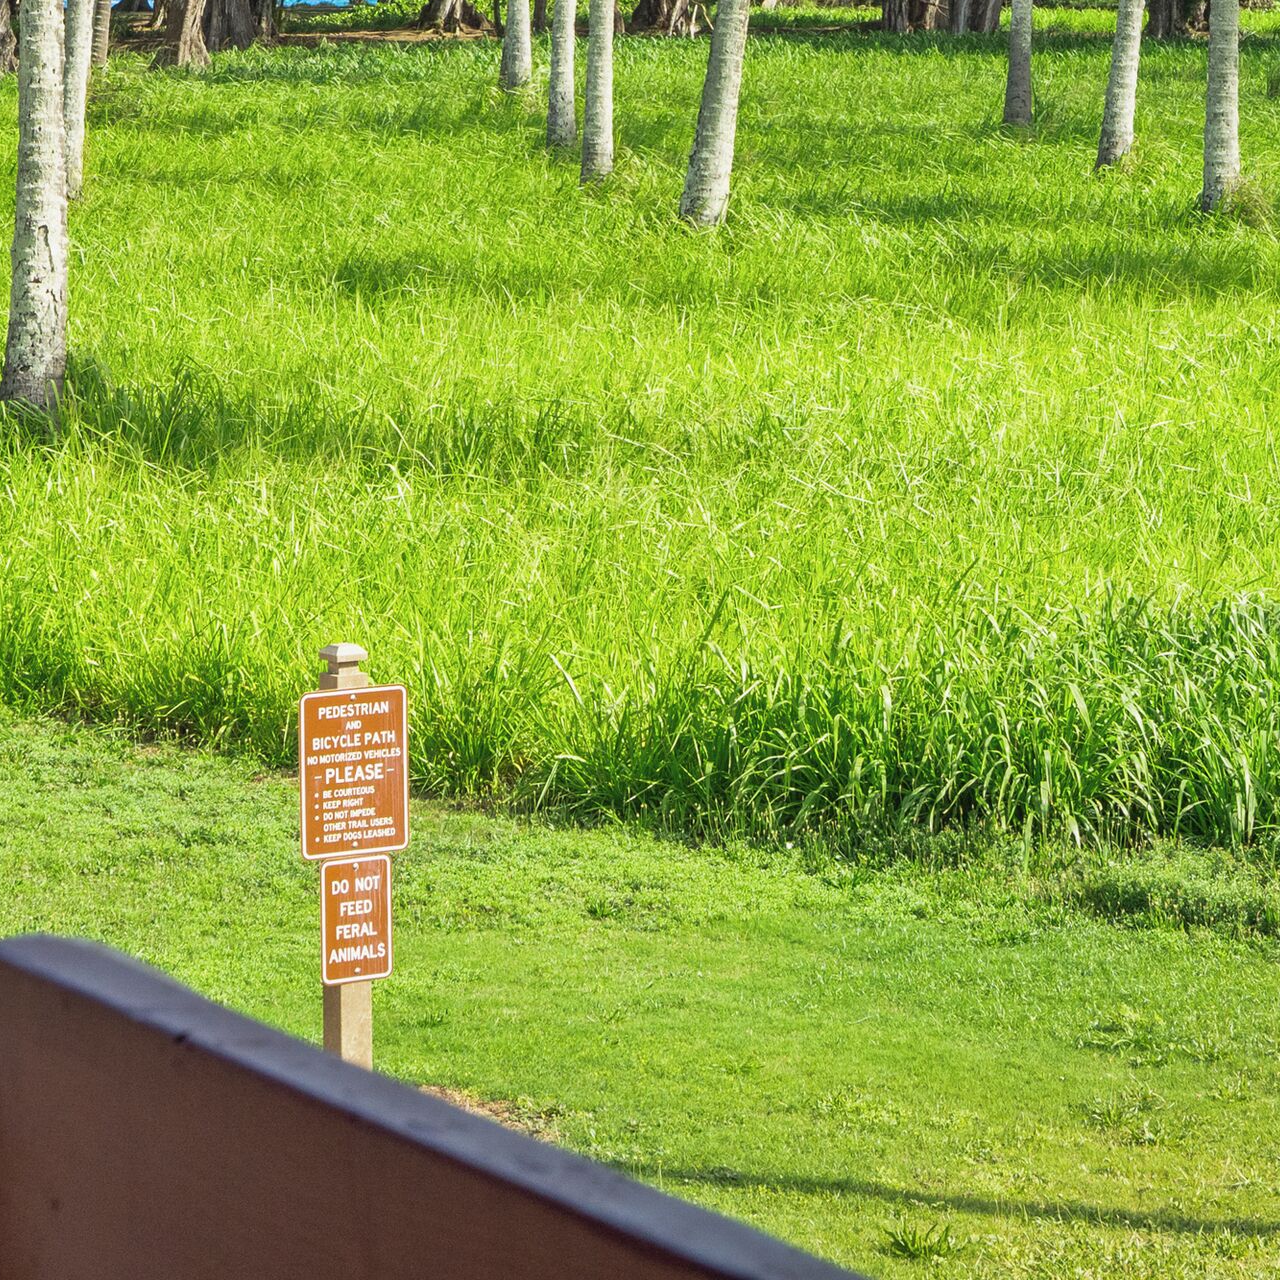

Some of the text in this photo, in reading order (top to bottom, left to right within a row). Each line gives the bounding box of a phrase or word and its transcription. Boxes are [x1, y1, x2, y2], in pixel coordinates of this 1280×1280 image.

[318, 701, 389, 720] PEDESTRIAN
[346, 720, 361, 730] AND
[312, 731, 395, 751] BICYCLE PATH
[307, 748, 401, 765] NO MOTORIZED VEHICLES
[325, 763, 384, 784] PLEASE
[323, 786, 375, 799] BE COURTEOUS
[323, 798, 363, 809] KEEP RIGHT
[323, 808, 376, 821] DO NOT IMPEDE
[323, 817, 393, 832] OTHER TRAIL USERS
[323, 828, 395, 843] KEEP DOGS LEASHED
[332, 876, 380, 895] DO NOT
[340, 900, 372, 916] FEED
[336, 922, 377, 940] FERAL
[329, 943, 386, 964] ANIMALS
